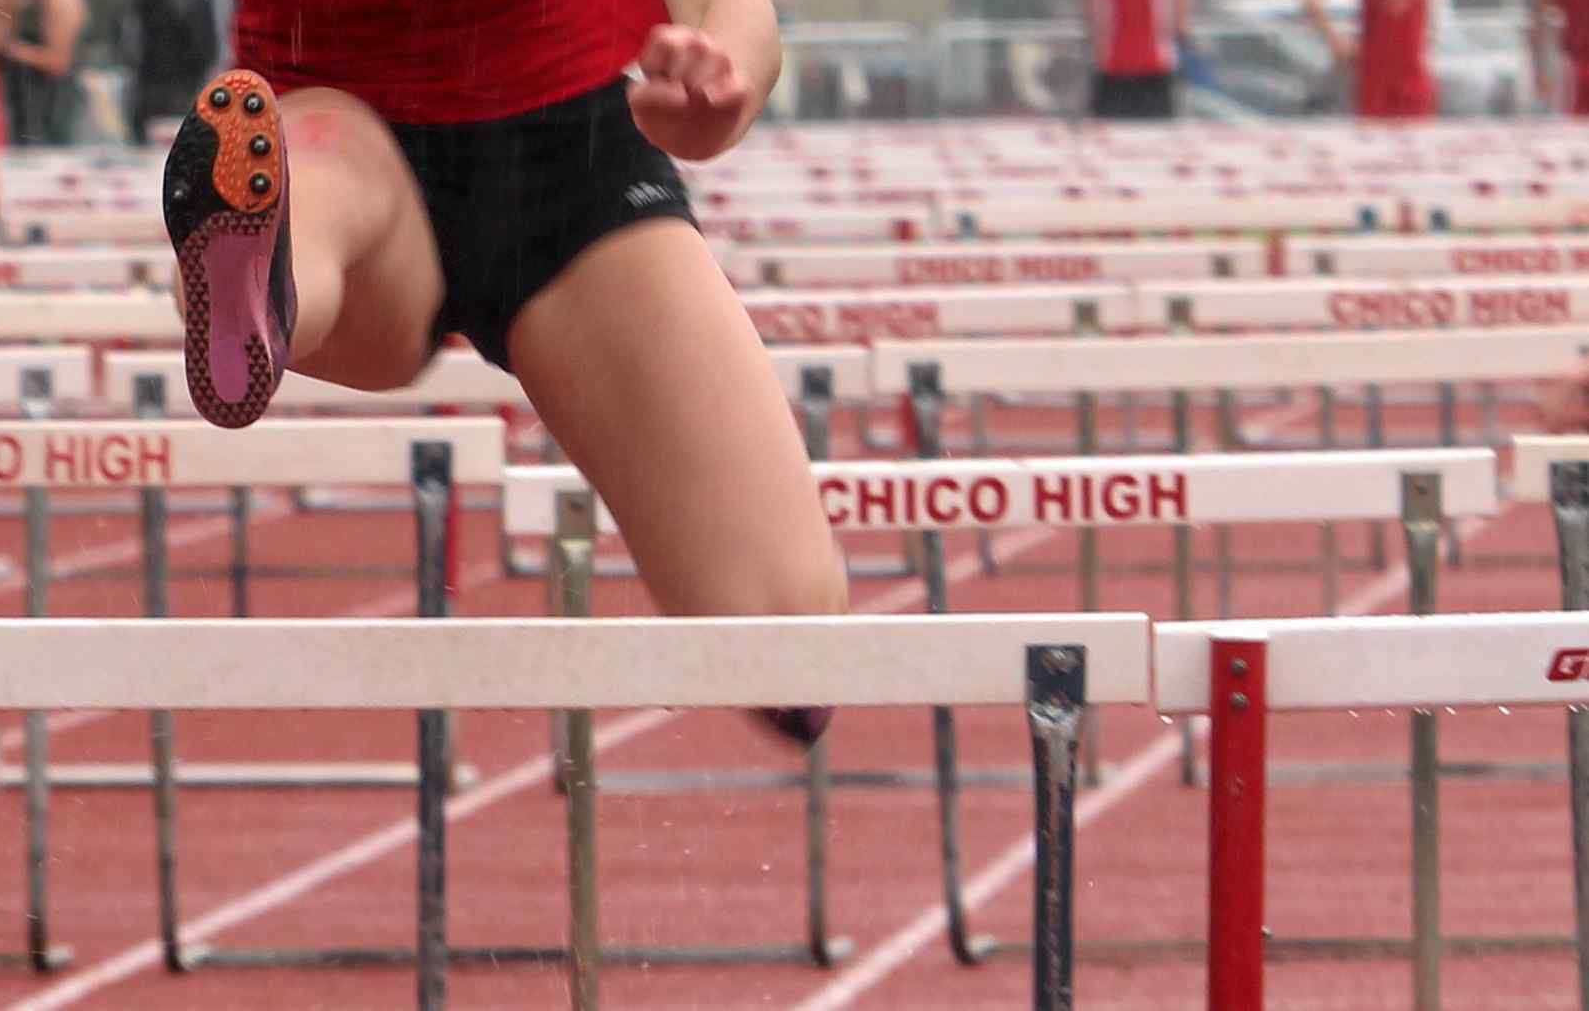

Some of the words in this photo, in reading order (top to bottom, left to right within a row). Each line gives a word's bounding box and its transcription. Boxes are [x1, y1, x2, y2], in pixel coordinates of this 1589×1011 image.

[45, 433, 172, 483] HIGH
[818, 476, 1010, 525] CHICO
[1033, 473, 1187, 521] HIGH
